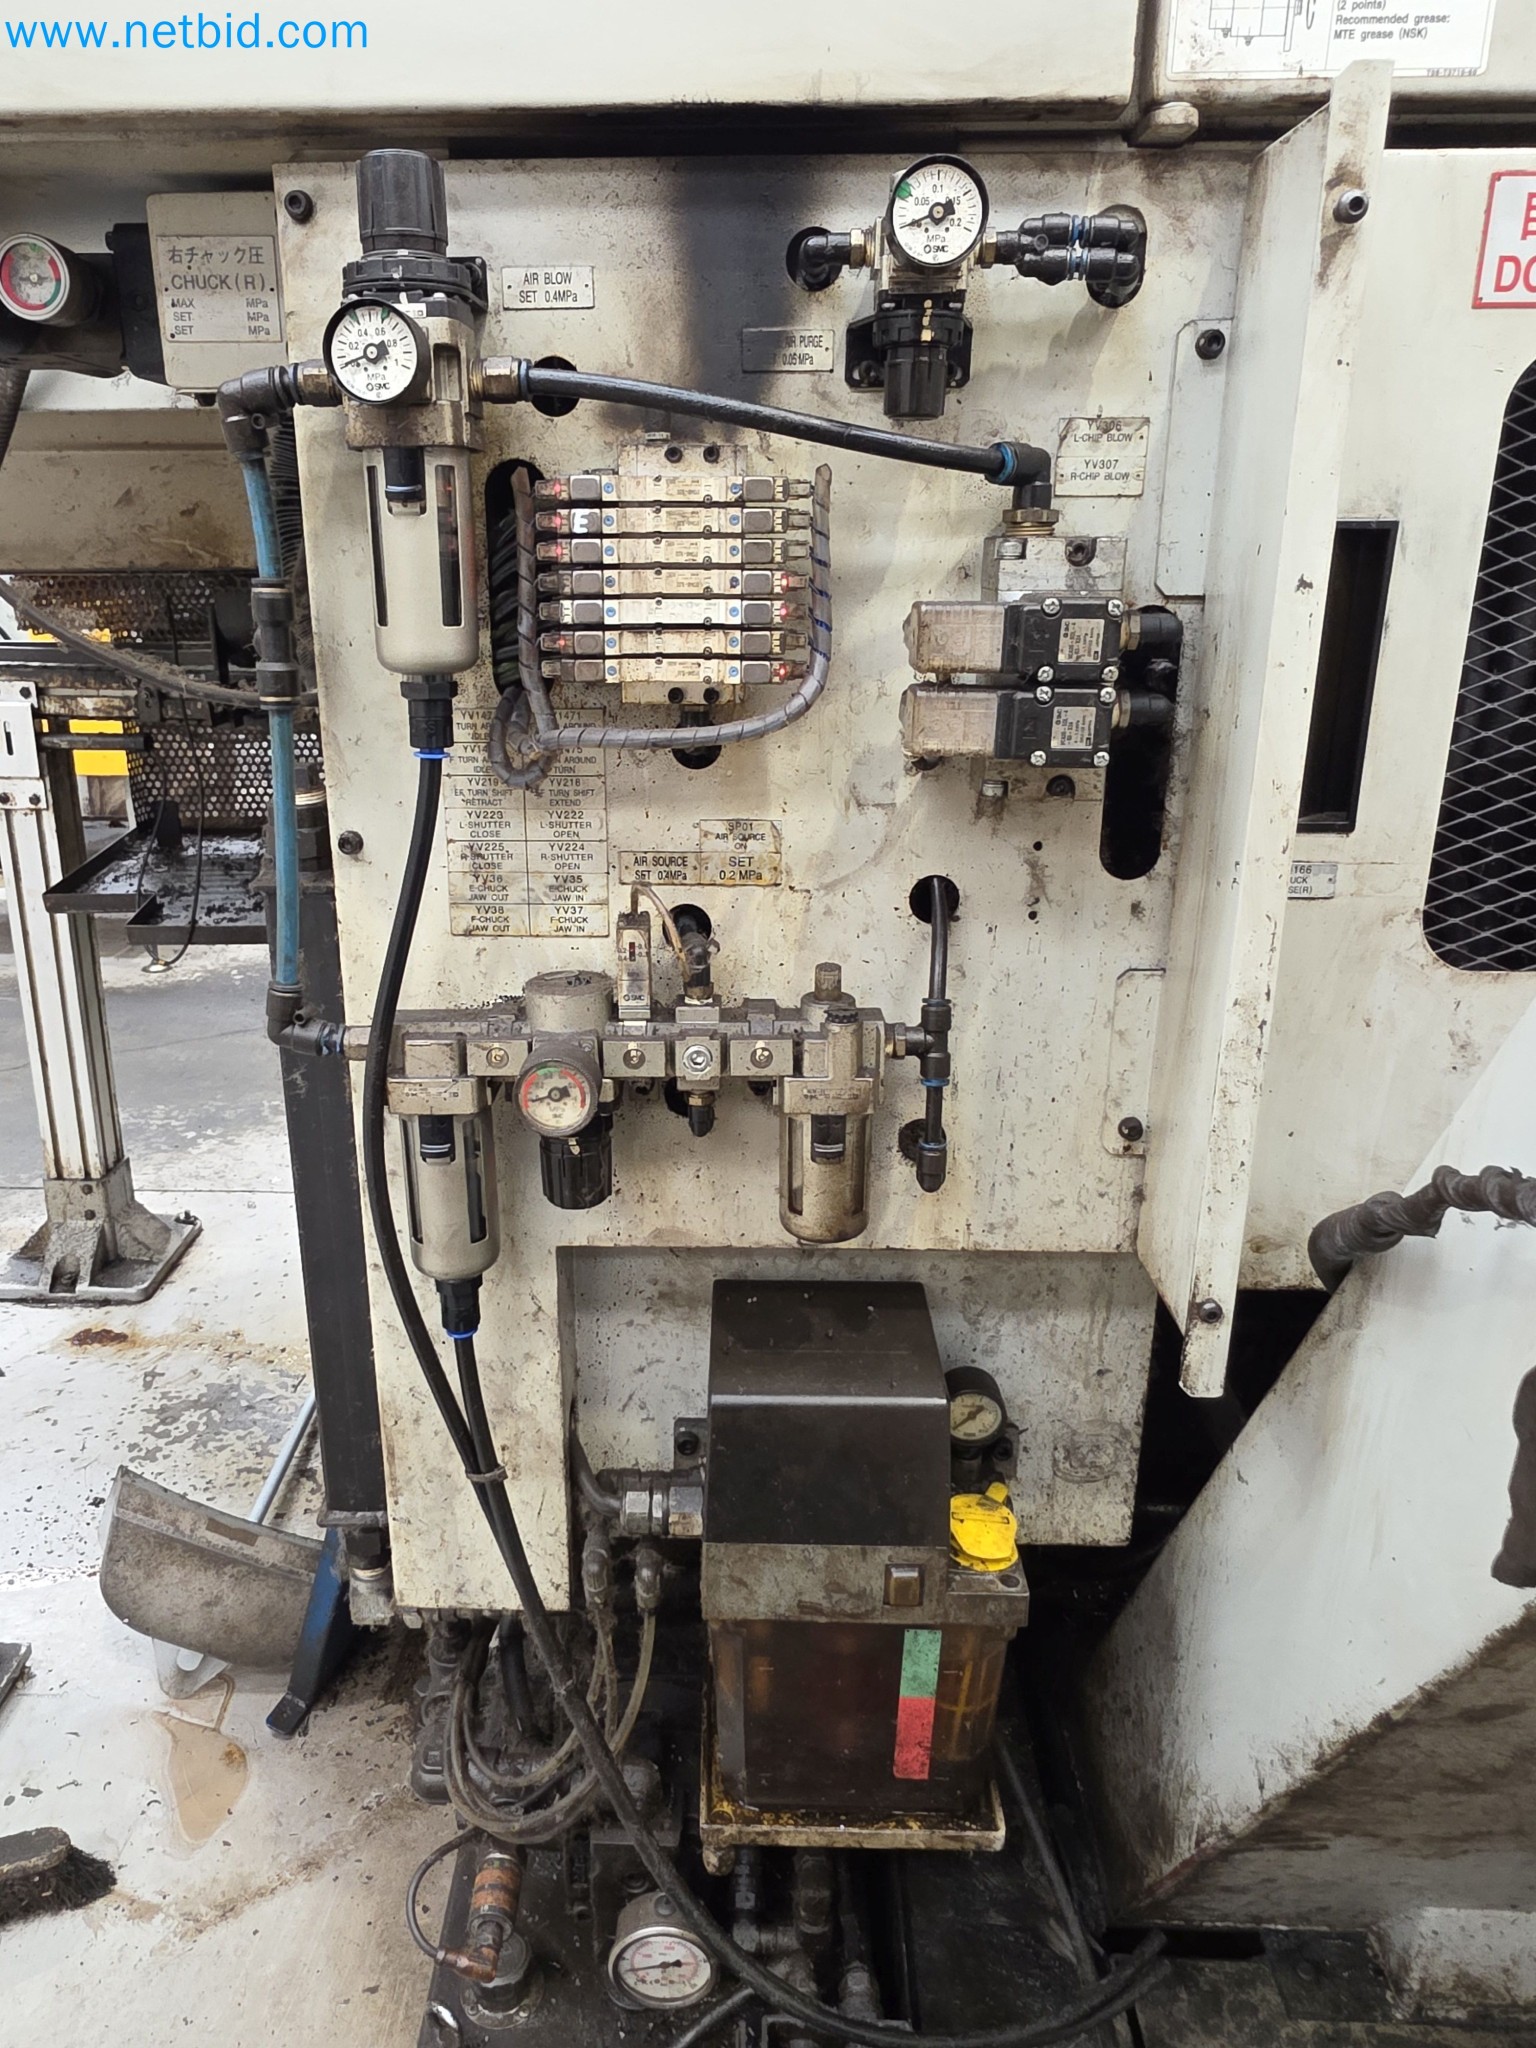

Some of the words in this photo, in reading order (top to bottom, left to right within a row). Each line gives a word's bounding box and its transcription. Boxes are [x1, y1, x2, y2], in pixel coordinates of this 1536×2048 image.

[1336, 13, 1409, 25] Recommended
[1413, 14, 1450, 26] grease:
[1333, 29, 1355, 40] MTE
[1360, 30, 1393, 42] grease
[1398, 27, 1428, 40] (NSK)
[932, 184, 943, 193] 0.1
[949, 218, 962, 227] 0.2
[926, 234, 946, 243] MPa
[168, 246, 264, 264] 右チャック圧
[523, 272, 539, 285] AIR
[544, 271, 572, 285] BLOW
[519, 290, 537, 303] SET
[545, 290, 578, 303] 0.4MPa
[171, 298, 195, 308] MAX
[246, 298, 269, 308] MPa
[173, 312, 192, 321] SET
[247, 312, 270, 321] MPa
[174, 325, 194, 335] SET
[248, 325, 271, 336] MPa
[387, 340, 398, 348] 0.8
[799, 334, 824, 348] PURGE
[349, 342, 359, 350] 0.2
[367, 373, 386, 381] MPa
[1087, 420, 1123, 432] YV306
[1073, 433, 1103, 442] L-CHIP
[1107, 433, 1133, 442] BLOW
[1084, 459, 1119, 469] YV307
[1070, 472, 1100, 481] R-CHIP
[1104, 472, 1130, 481] BLOW
[456, 722, 478, 730] TURN
[458, 756, 479, 764] TURN
[564, 756, 597, 764] AROUND
[473, 766, 492, 774] IDLE
[553, 766, 576, 774] TURN
[467, 788, 489, 797] TURN
[491, 788, 513, 797] SHIFT
[548, 788, 570, 797] TURN
[573, 788, 596, 797] SHIFT
[465, 798, 503, 807] RETRACT
[549, 799, 582, 807] EXTEND
[466, 810, 504, 820] YV223
[547, 810, 584, 820] YV222
[459, 821, 511, 829] L-SHUTTER
[540, 821, 592, 829] L-SHUTTER
[728, 822, 753, 832] SP01
[470, 830, 501, 839] CLOSE
[553, 830, 580, 839] OPEN
[715, 833, 728, 841] AIR
[732, 833, 766, 842] SOURCE
[468, 842, 505, 852] YV225
[549, 842, 585, 852] YV224
[734, 842, 748, 850] ON
[540, 853, 594, 861] R-SHUTTER
[633, 856, 648, 867] AIR
[651, 855, 688, 868] SOURCE
[729, 856, 754, 867] SET
[471, 862, 503, 871] CLOSE
[554, 862, 581, 871] OPEN
[553, 874, 583, 884] YV35
[634, 869, 651, 880] SET
[738, 870, 763, 880] MPa
[469, 884, 508, 893] E-CHUCK
[548, 885, 588, 893] E-CHUCK
[468, 893, 487, 901] JAW
[490, 893, 509, 901] OUT
[552, 894, 571, 902] JAW
[575, 894, 584, 902] IN
[475, 905, 505, 915] YV38
[554, 906, 584, 915] YV37
[470, 915, 510, 924] F-CHUCK
[550, 916, 588, 924] F-CHUCK
[471, 924, 488, 932] JAW
[492, 924, 511, 932] OUT
